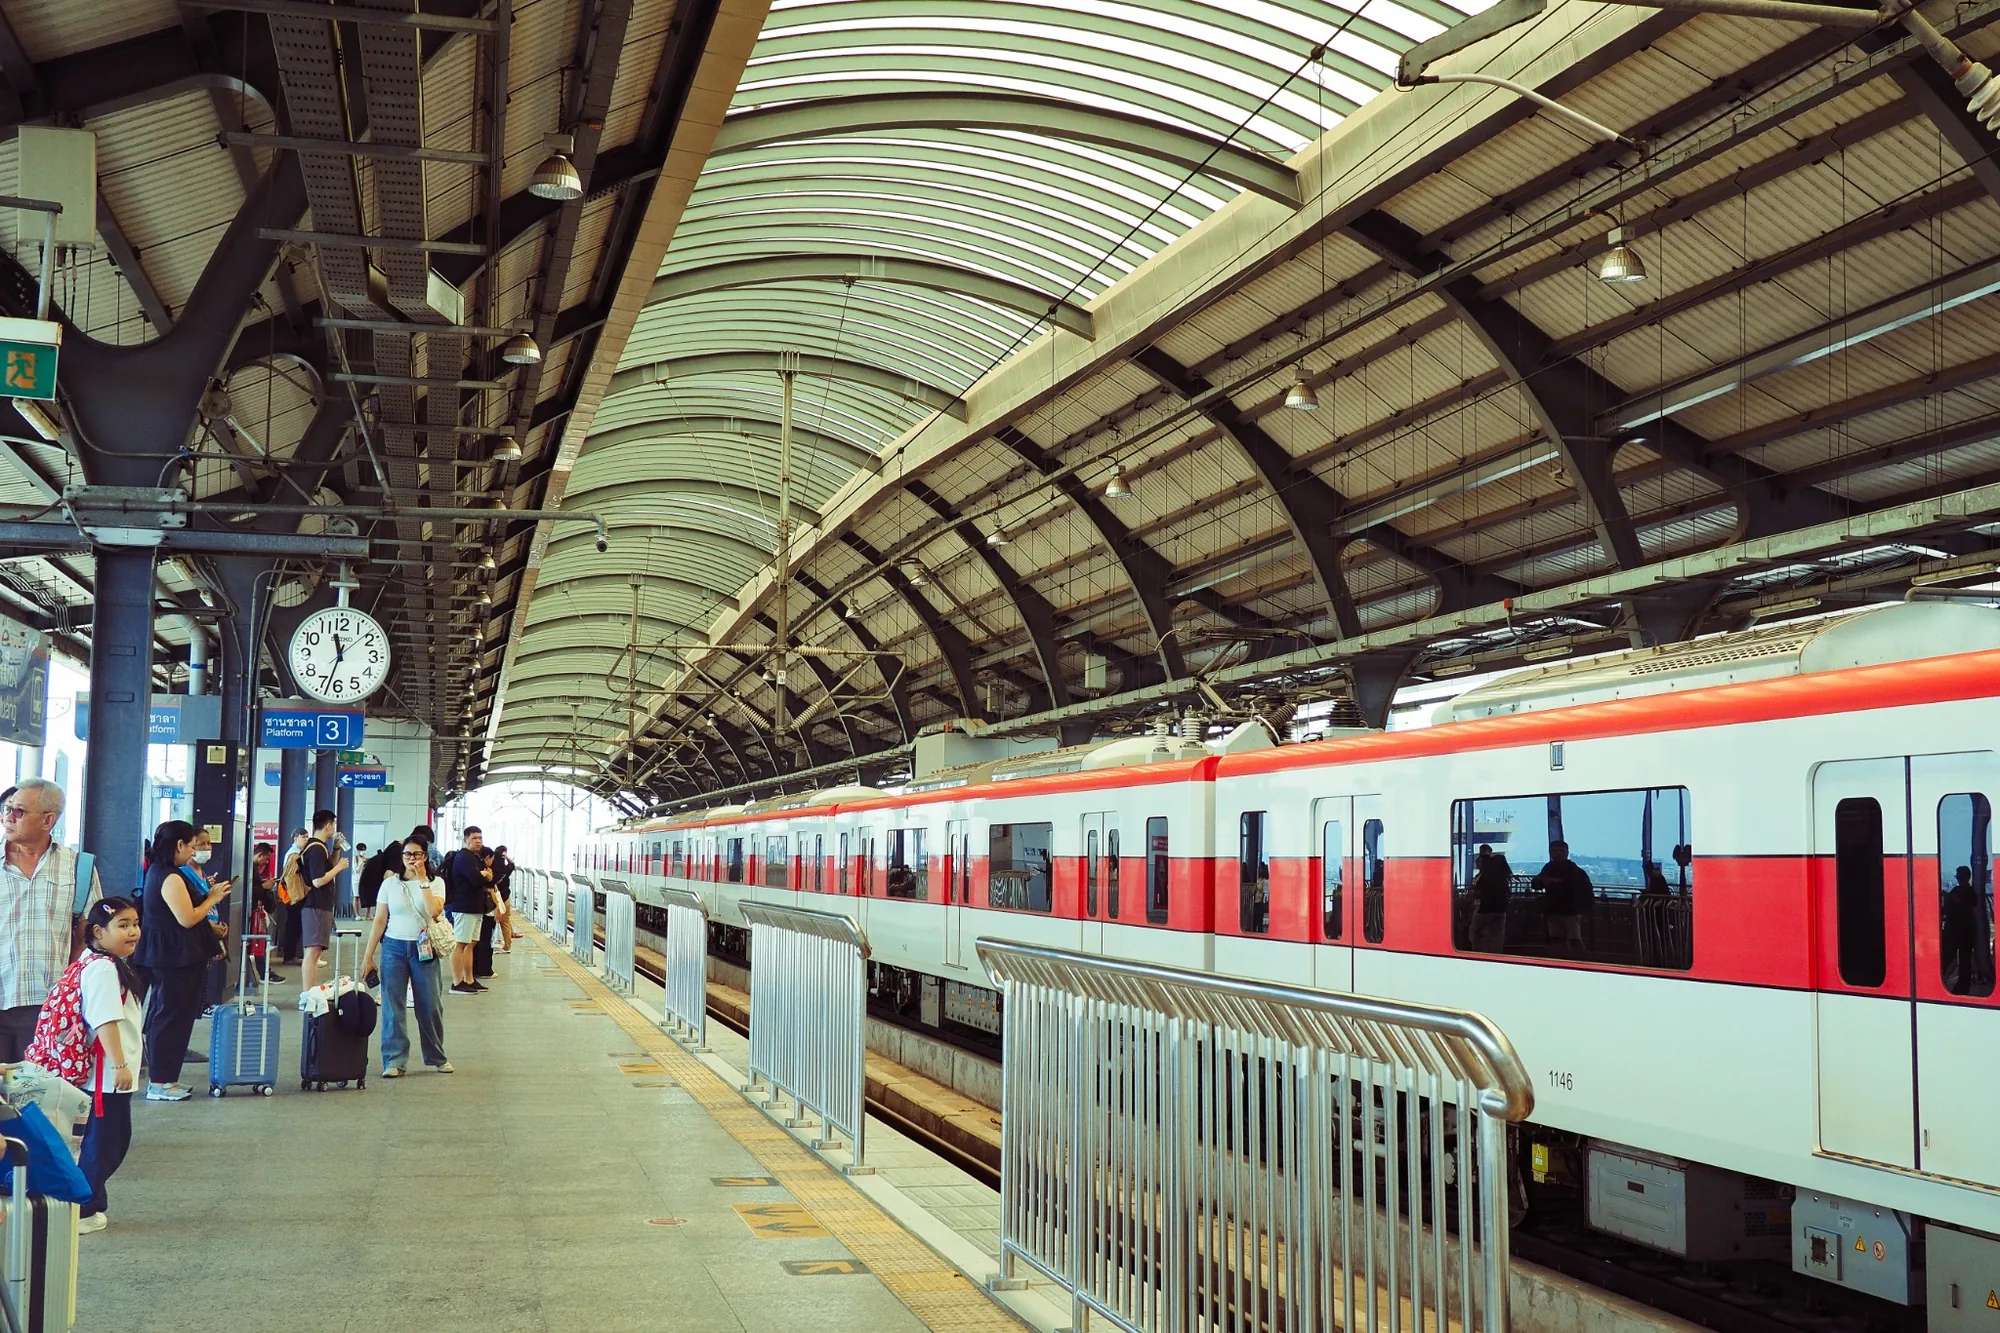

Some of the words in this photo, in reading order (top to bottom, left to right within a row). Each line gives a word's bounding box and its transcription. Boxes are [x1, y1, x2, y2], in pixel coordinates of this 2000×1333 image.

[320, 620, 332, 634] 11
[335, 617, 350, 632] 12
[356, 622, 360, 635] 1
[306, 632, 320, 645] 10
[364, 633, 374, 647] 2
[300, 647, 311, 661] 9
[368, 650, 379, 664] 3
[305, 663, 316, 677] 8
[362, 666, 373, 679] 4
[318, 675, 329, 689] 7
[332, 679, 343, 693] 6
[349, 677, 360, 690] 5
[265, 717, 314, 727] ชานชาลา
[325, 720, 340, 740] 3
[266, 728, 304, 737] Platform
[1549, 1070, 1573, 1091] 1146
